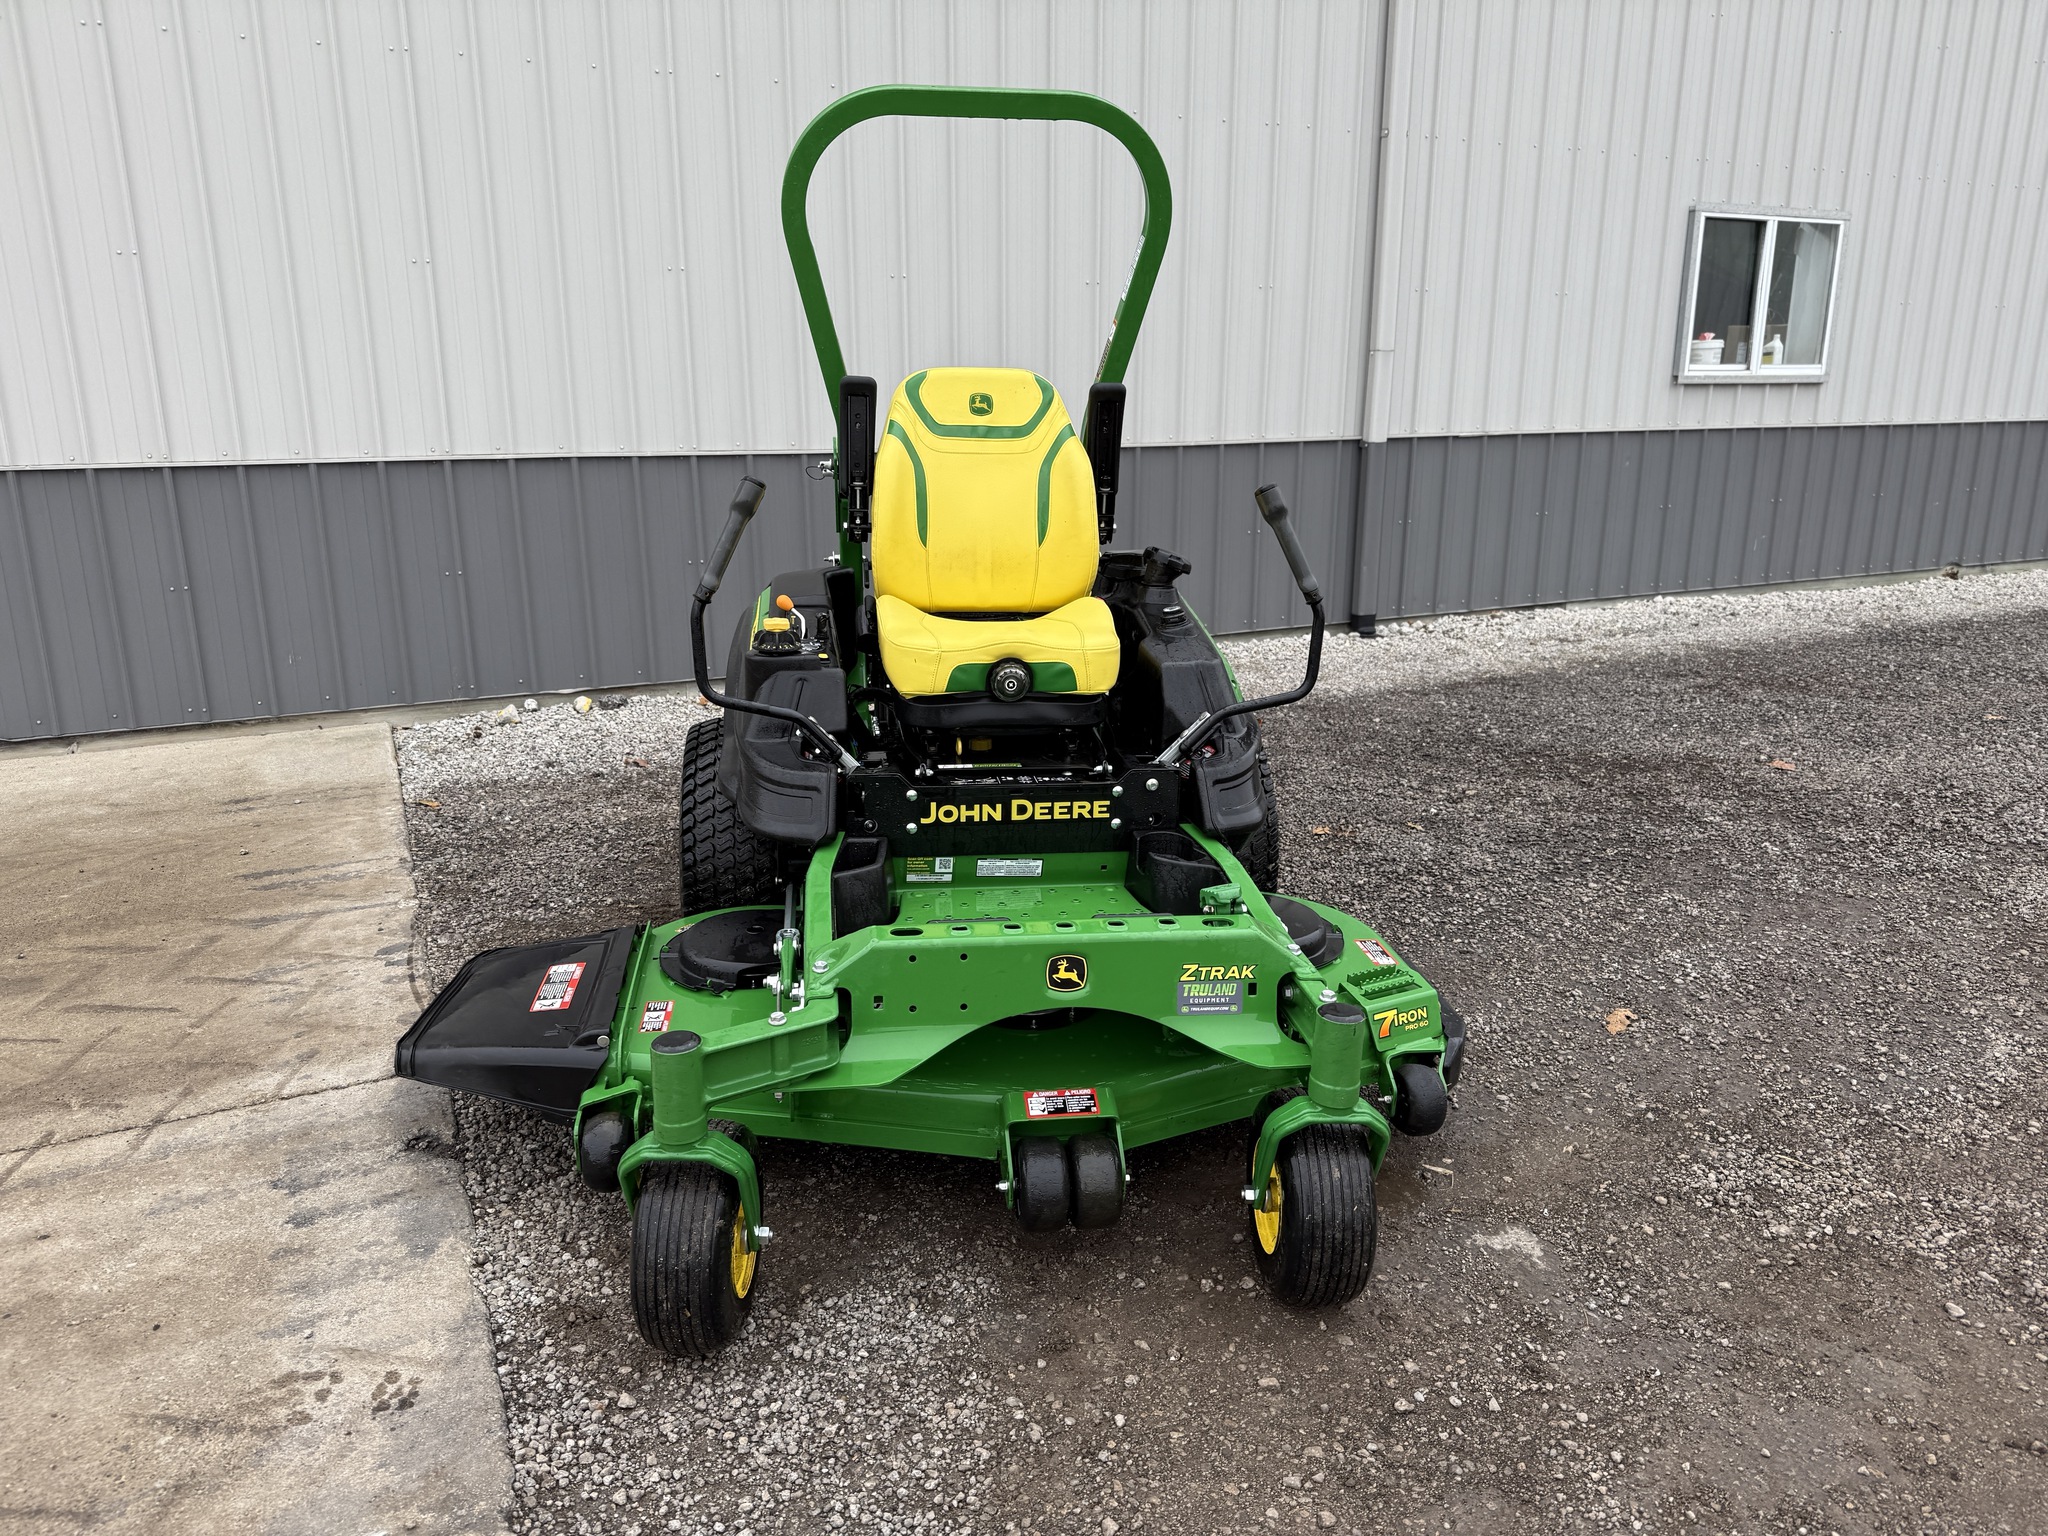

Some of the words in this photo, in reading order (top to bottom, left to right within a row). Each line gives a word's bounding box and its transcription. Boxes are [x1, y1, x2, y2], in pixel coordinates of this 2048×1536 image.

[920, 801, 1002, 824] JOHN
[1010, 799, 1111, 821] DEERE
[1179, 963, 1257, 982] ZTRAK
[1183, 983, 1237, 997] TRULAND
[1405, 1023, 1419, 1031] PRO
[1419, 1020, 1429, 1028] 60
